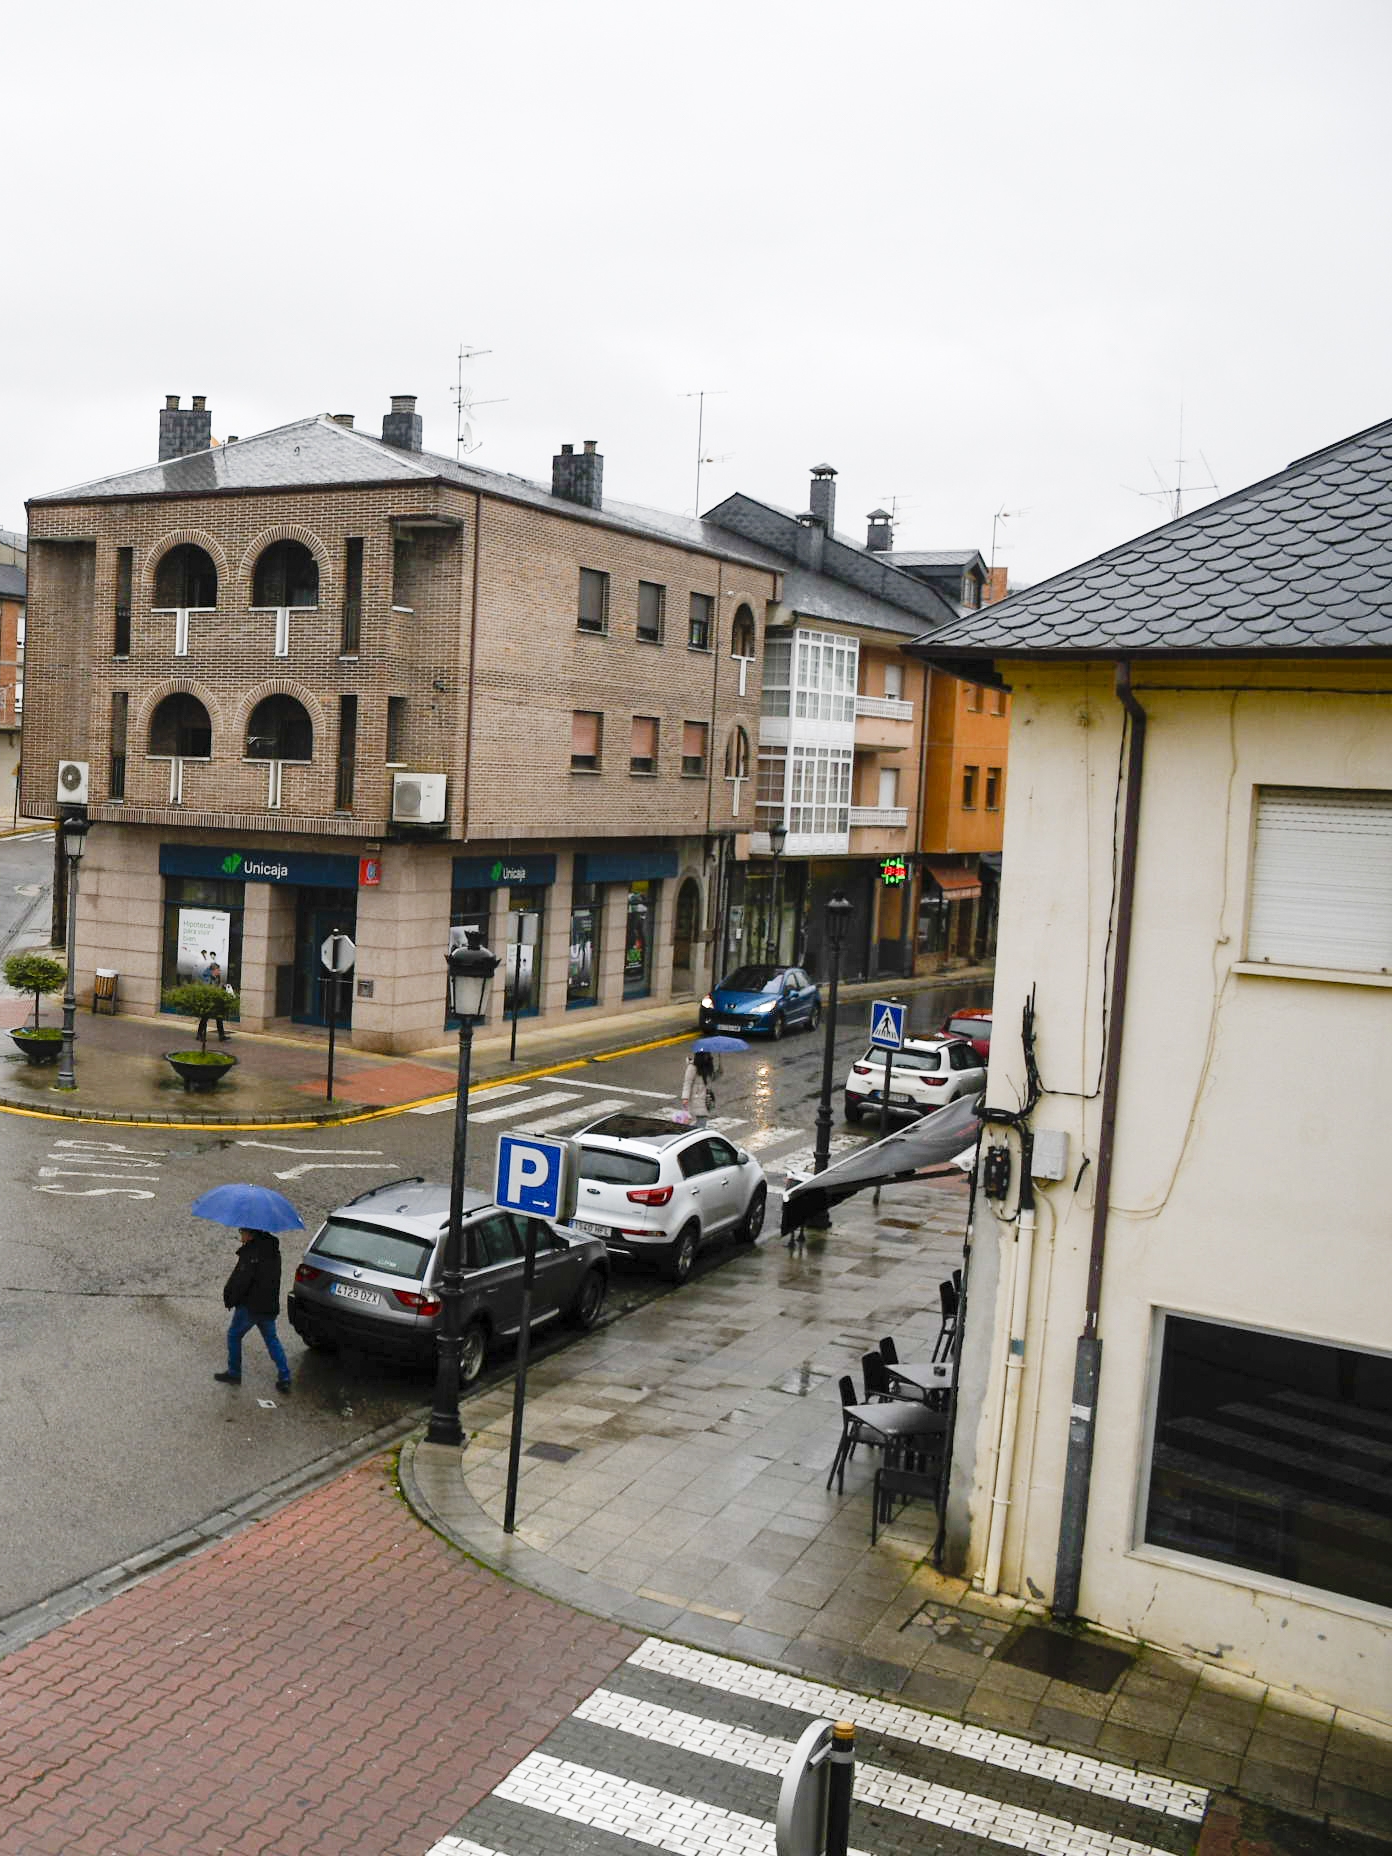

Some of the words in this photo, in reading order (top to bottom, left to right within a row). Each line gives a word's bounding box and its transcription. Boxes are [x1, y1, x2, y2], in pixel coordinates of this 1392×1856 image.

[244, 861, 288, 879] Unicaja
[503, 866, 526, 882] Unicaja
[32, 1139, 168, 1200] STOP
[507, 1144, 549, 1204] P
[336, 1285, 359, 1298] 4129
[360, 1290, 378, 1304] DZX
